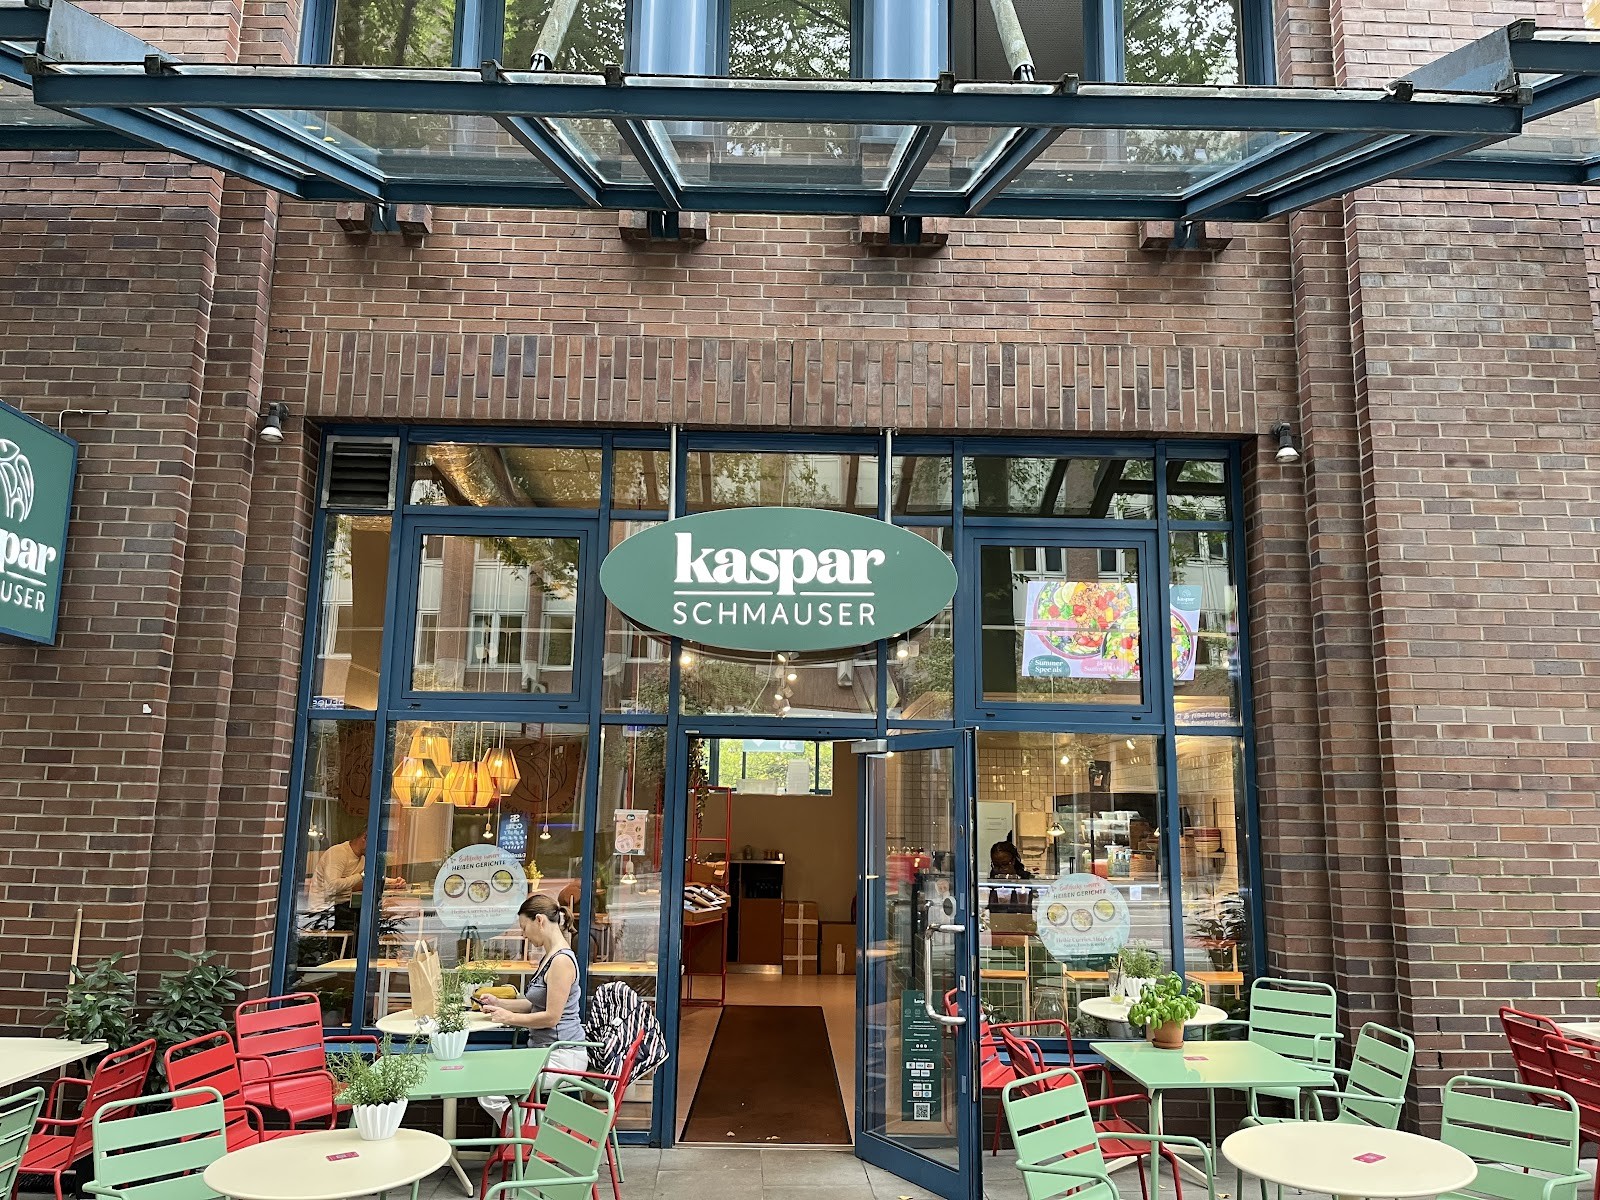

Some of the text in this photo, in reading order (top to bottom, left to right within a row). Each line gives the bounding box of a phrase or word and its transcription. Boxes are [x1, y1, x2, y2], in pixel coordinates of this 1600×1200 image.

[674, 532, 886, 595] kaspar
[673, 601, 875, 626] SCHMAUSER
[475, 860, 506, 868] GERICHTE
[1076, 888, 1106, 897] GERICHTE
